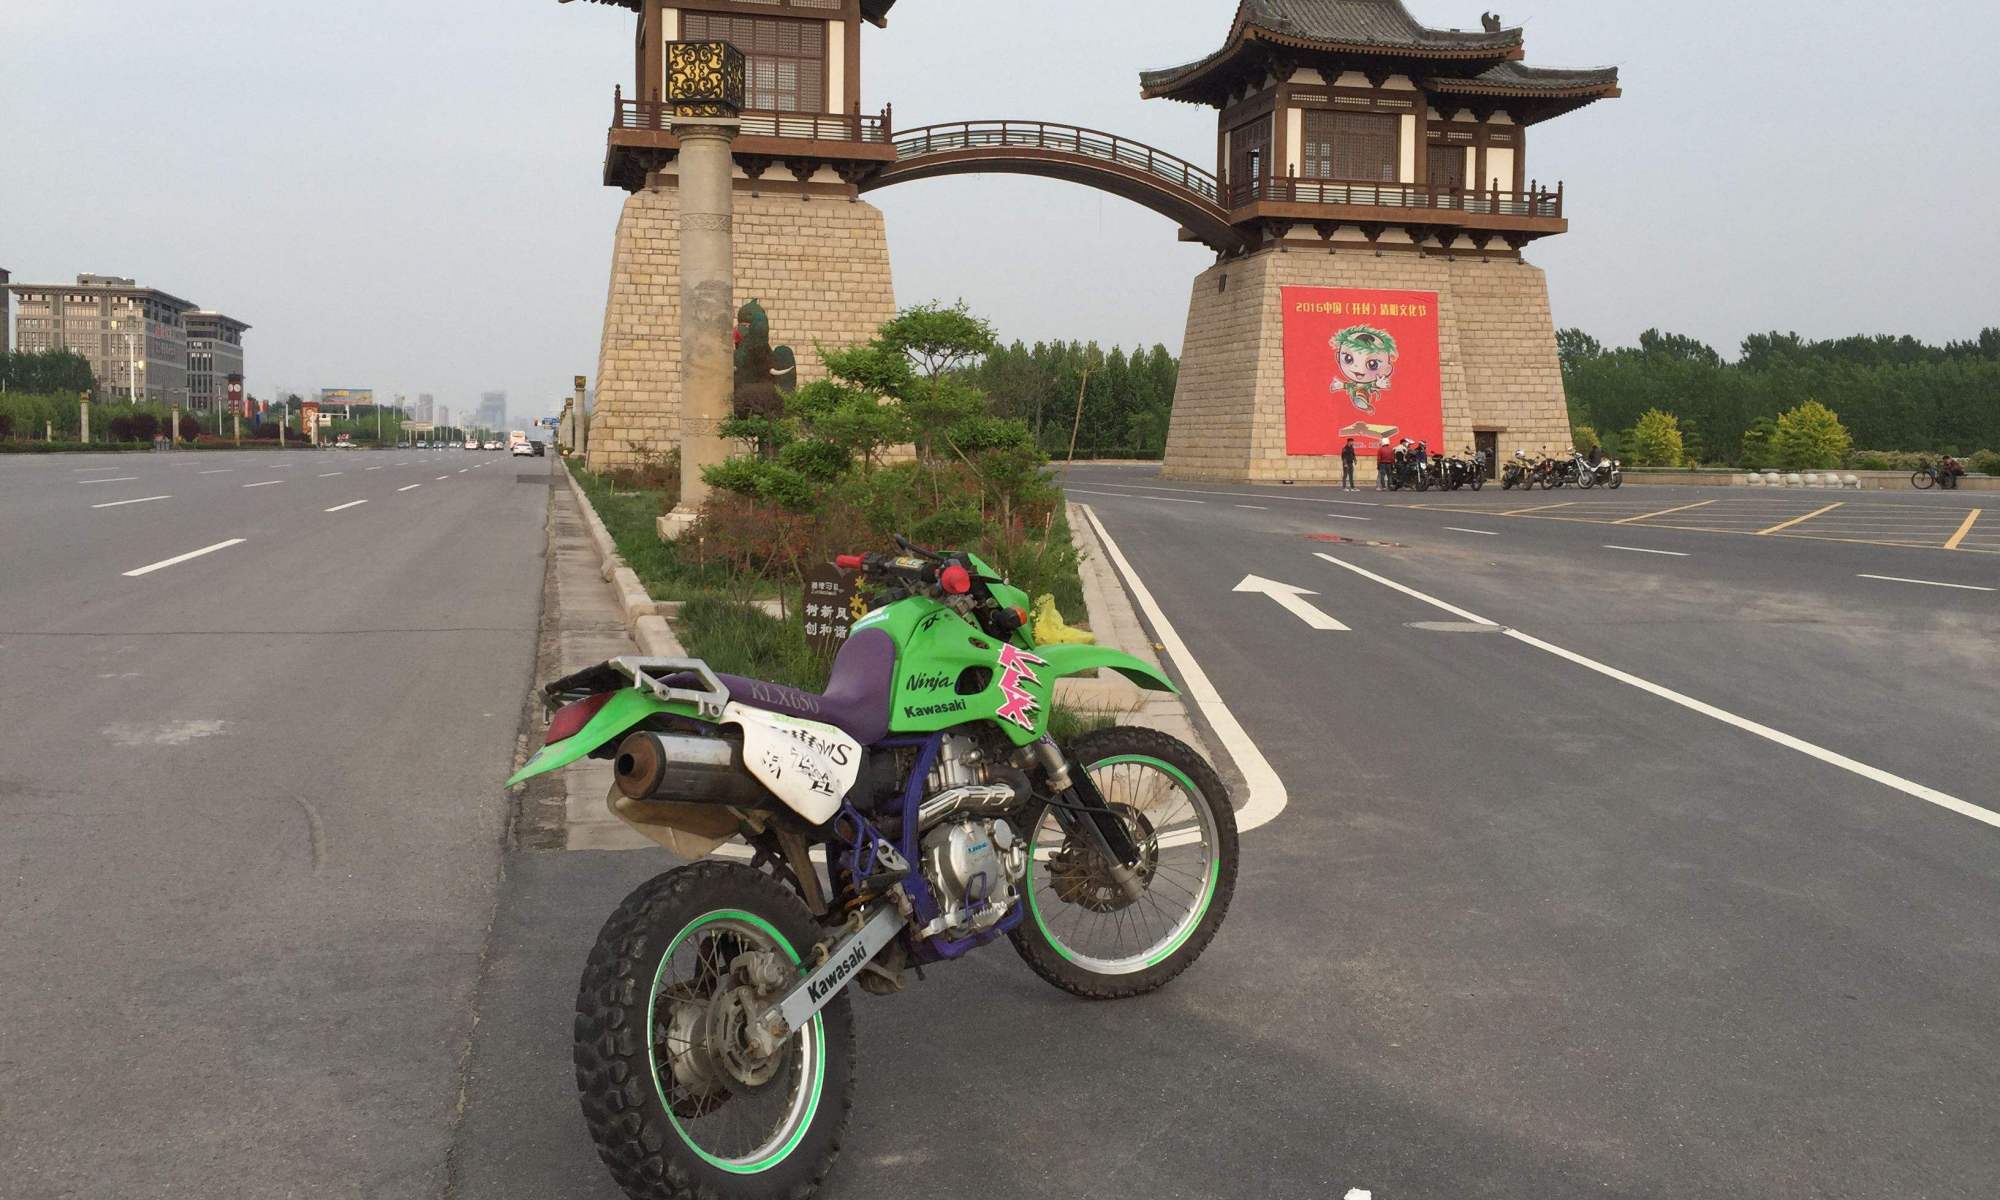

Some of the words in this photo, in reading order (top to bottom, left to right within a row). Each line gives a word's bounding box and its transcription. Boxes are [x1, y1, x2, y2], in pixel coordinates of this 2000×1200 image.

[805, 603, 850, 620] 树新风
[805, 621, 848, 639] 创和谐
[906, 671, 954, 693] Ninja
[751, 682, 819, 714] KLX650
[904, 699, 967, 718] Kawasaki
[806, 940, 867, 1004] Kawasaki
